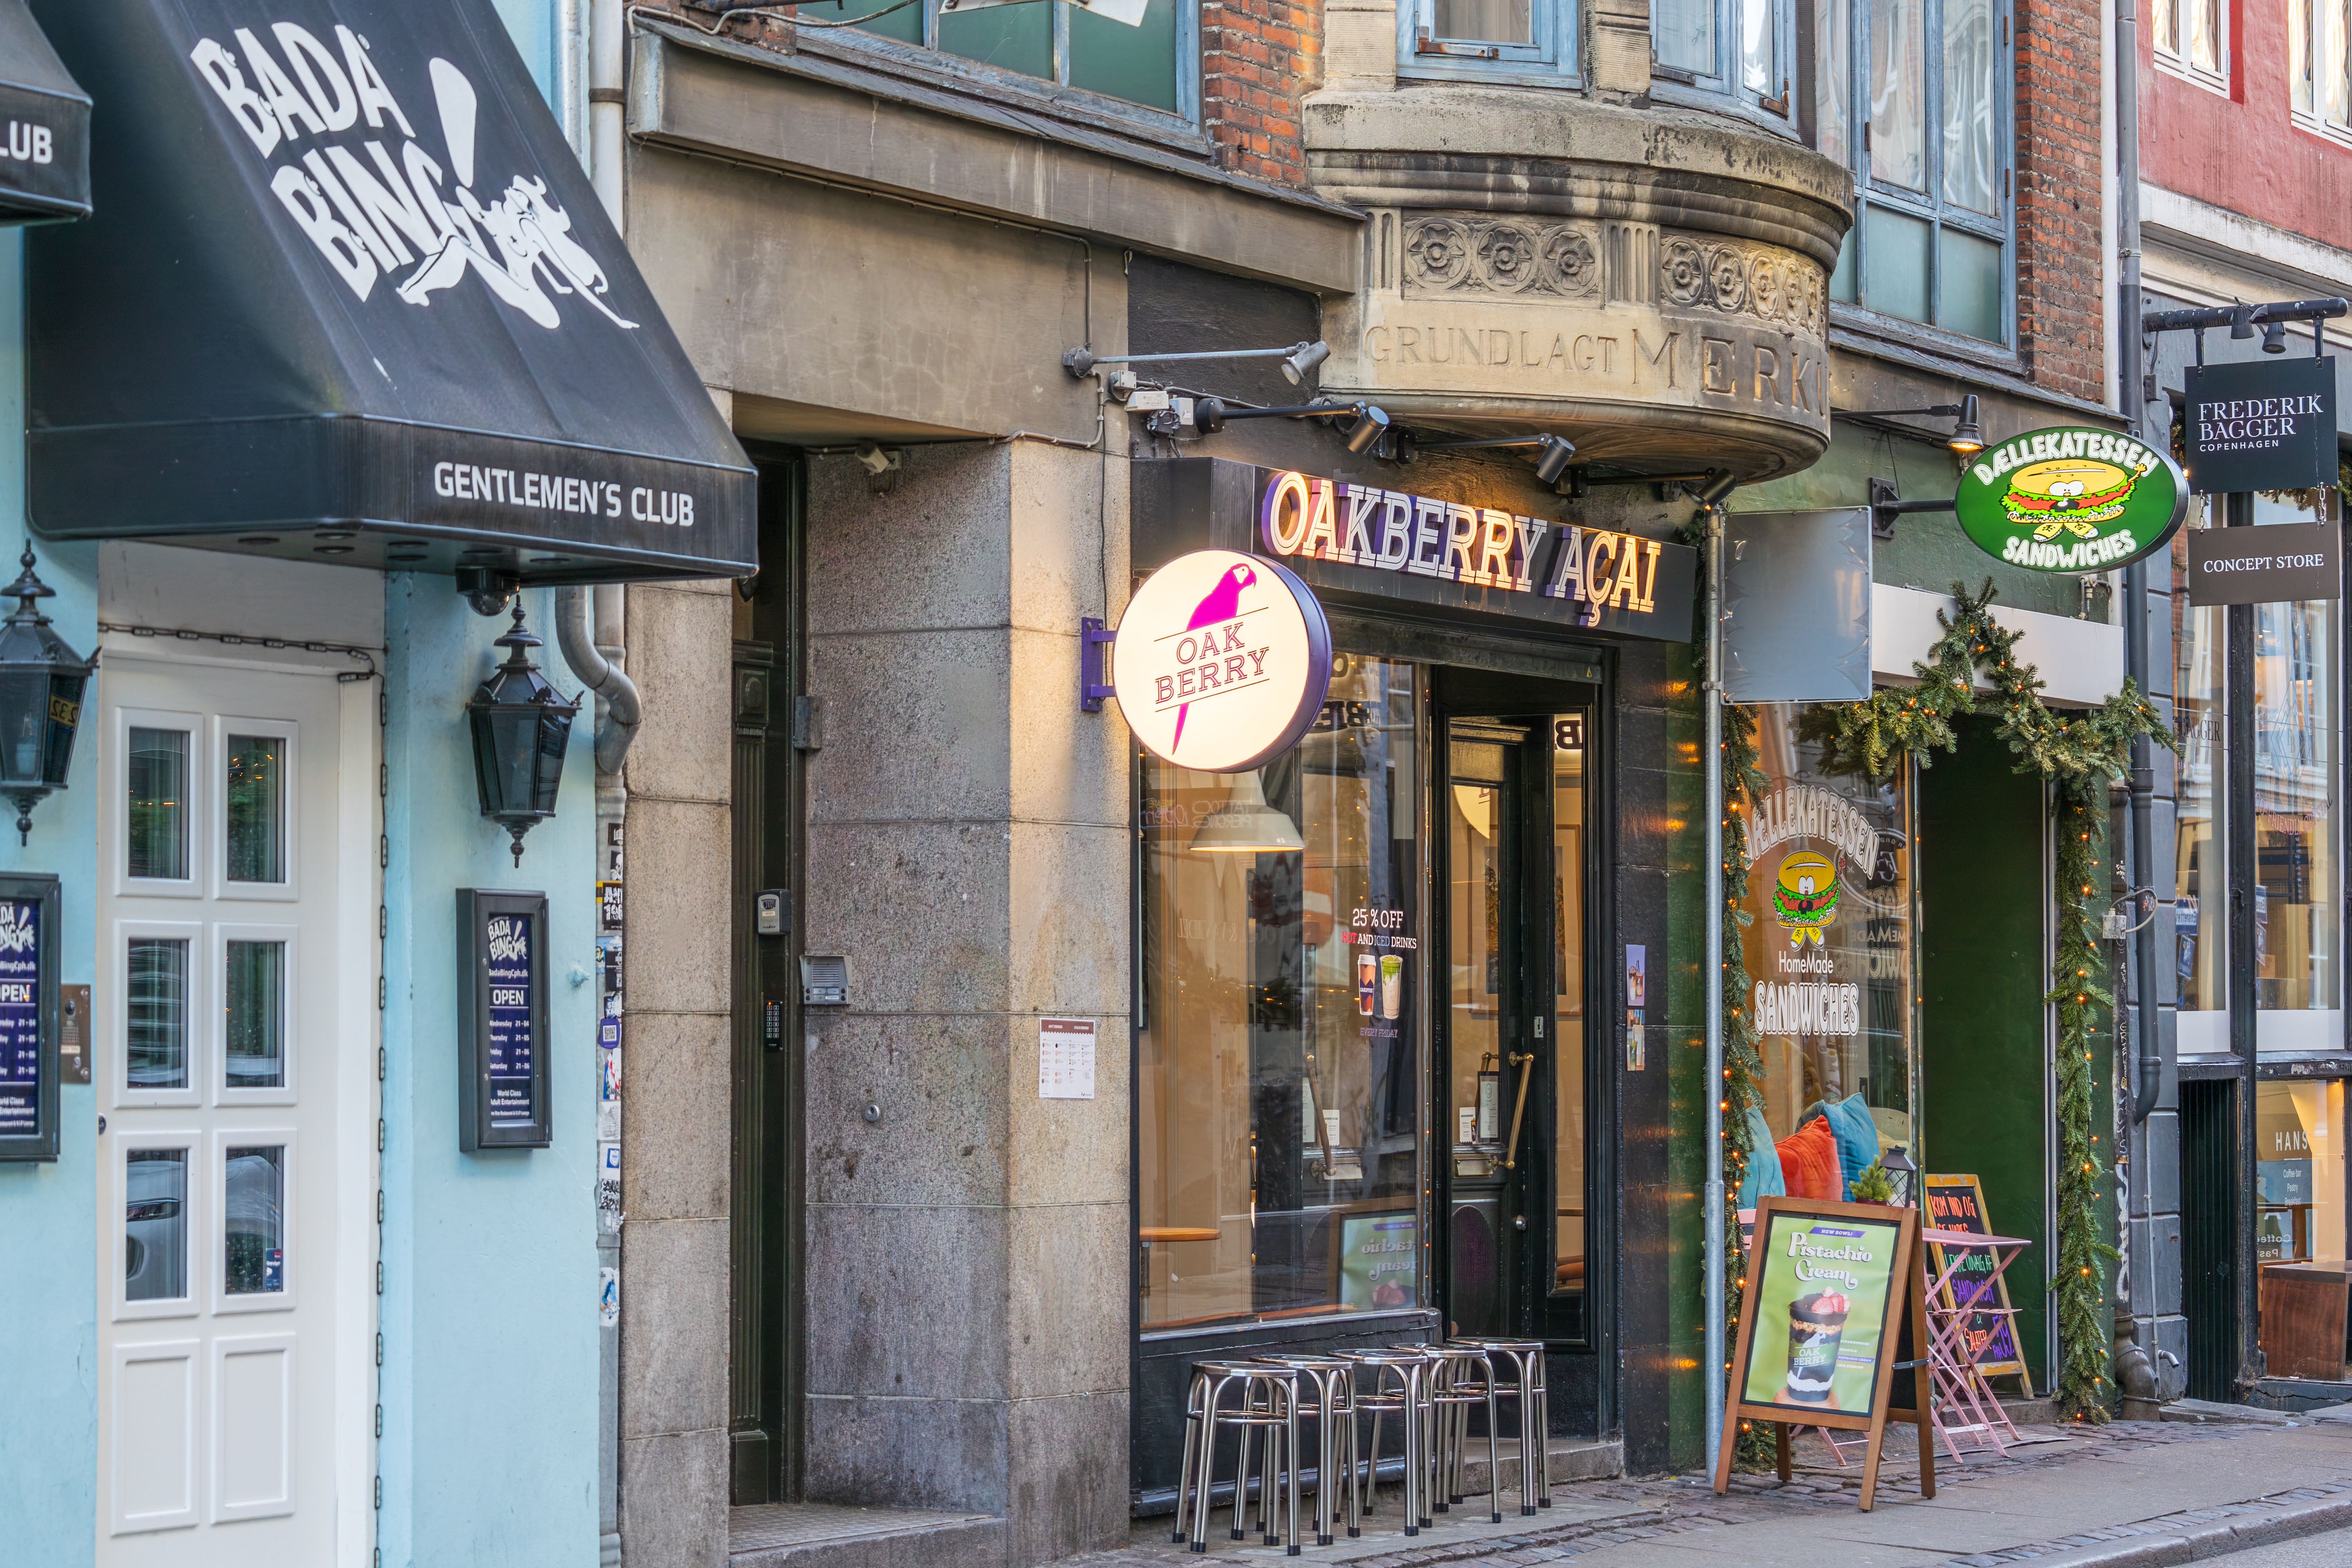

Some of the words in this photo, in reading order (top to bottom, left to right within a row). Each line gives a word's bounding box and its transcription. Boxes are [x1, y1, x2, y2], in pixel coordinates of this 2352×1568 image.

[190, 21, 415, 159] BADA
[0, 121, 53, 165] UB
[1364, 325, 1619, 374] GRUNDLAGT
[2198, 395, 2324, 422] FREDERIK
[2199, 417, 2296, 441] BAGGER
[2200, 439, 2280, 452] COPENHAGEN
[1973, 431, 2160, 486] DÆLLEKATESSEN
[630, 485, 695, 527] CLUB
[1262, 471, 1548, 593] OAKBERRY
[1547, 526, 1662, 627] AÇAI
[2002, 529, 2137, 568] SANDWICHES
[2204, 556, 2273, 573] CONCEPT
[2276, 554, 2324, 570] STORE
[1176, 621, 1245, 665] OAK
[1154, 646, 1271, 705] BERRY
[2182, 717, 2221, 742] BAGGER
[0, 905, 15, 925] DA
[1352, 908, 1367, 927] 25
[1370, 908, 1378, 927] %
[1380, 910, 1404, 929] OFF
[488, 920, 511, 941] BADA
[1342, 931, 1357, 944] HOT
[1357, 933, 1374, 945] AND
[1374, 934, 1390, 947] ICED
[1391, 935, 1417, 949] DRINKS
[1779, 951, 1833, 974] HomeMade
[493, 989, 524, 1005] OPEN
[1754, 980, 1859, 1036] SANDWICHES
[1360, 1027, 1378, 1037] EVERY
[1378, 1028, 1398, 1038] FRIDAY
[497, 1089, 510, 1097] World
[2276, 1130, 2308, 1151] HANS
[2283, 1169, 2295, 1178] Coffee
[2287, 1183, 2298, 1194] Pastry
[1929, 1194, 1949, 1218] KOM
[2284, 1196, 2301, 1206] Breakfast
[1787, 1232, 1873, 1264] Pistachio
[1795, 1259, 1858, 1290] Cream
[1793, 1354, 1827, 1366] BERRY
[1799, 1347, 1821, 1357] OAK
